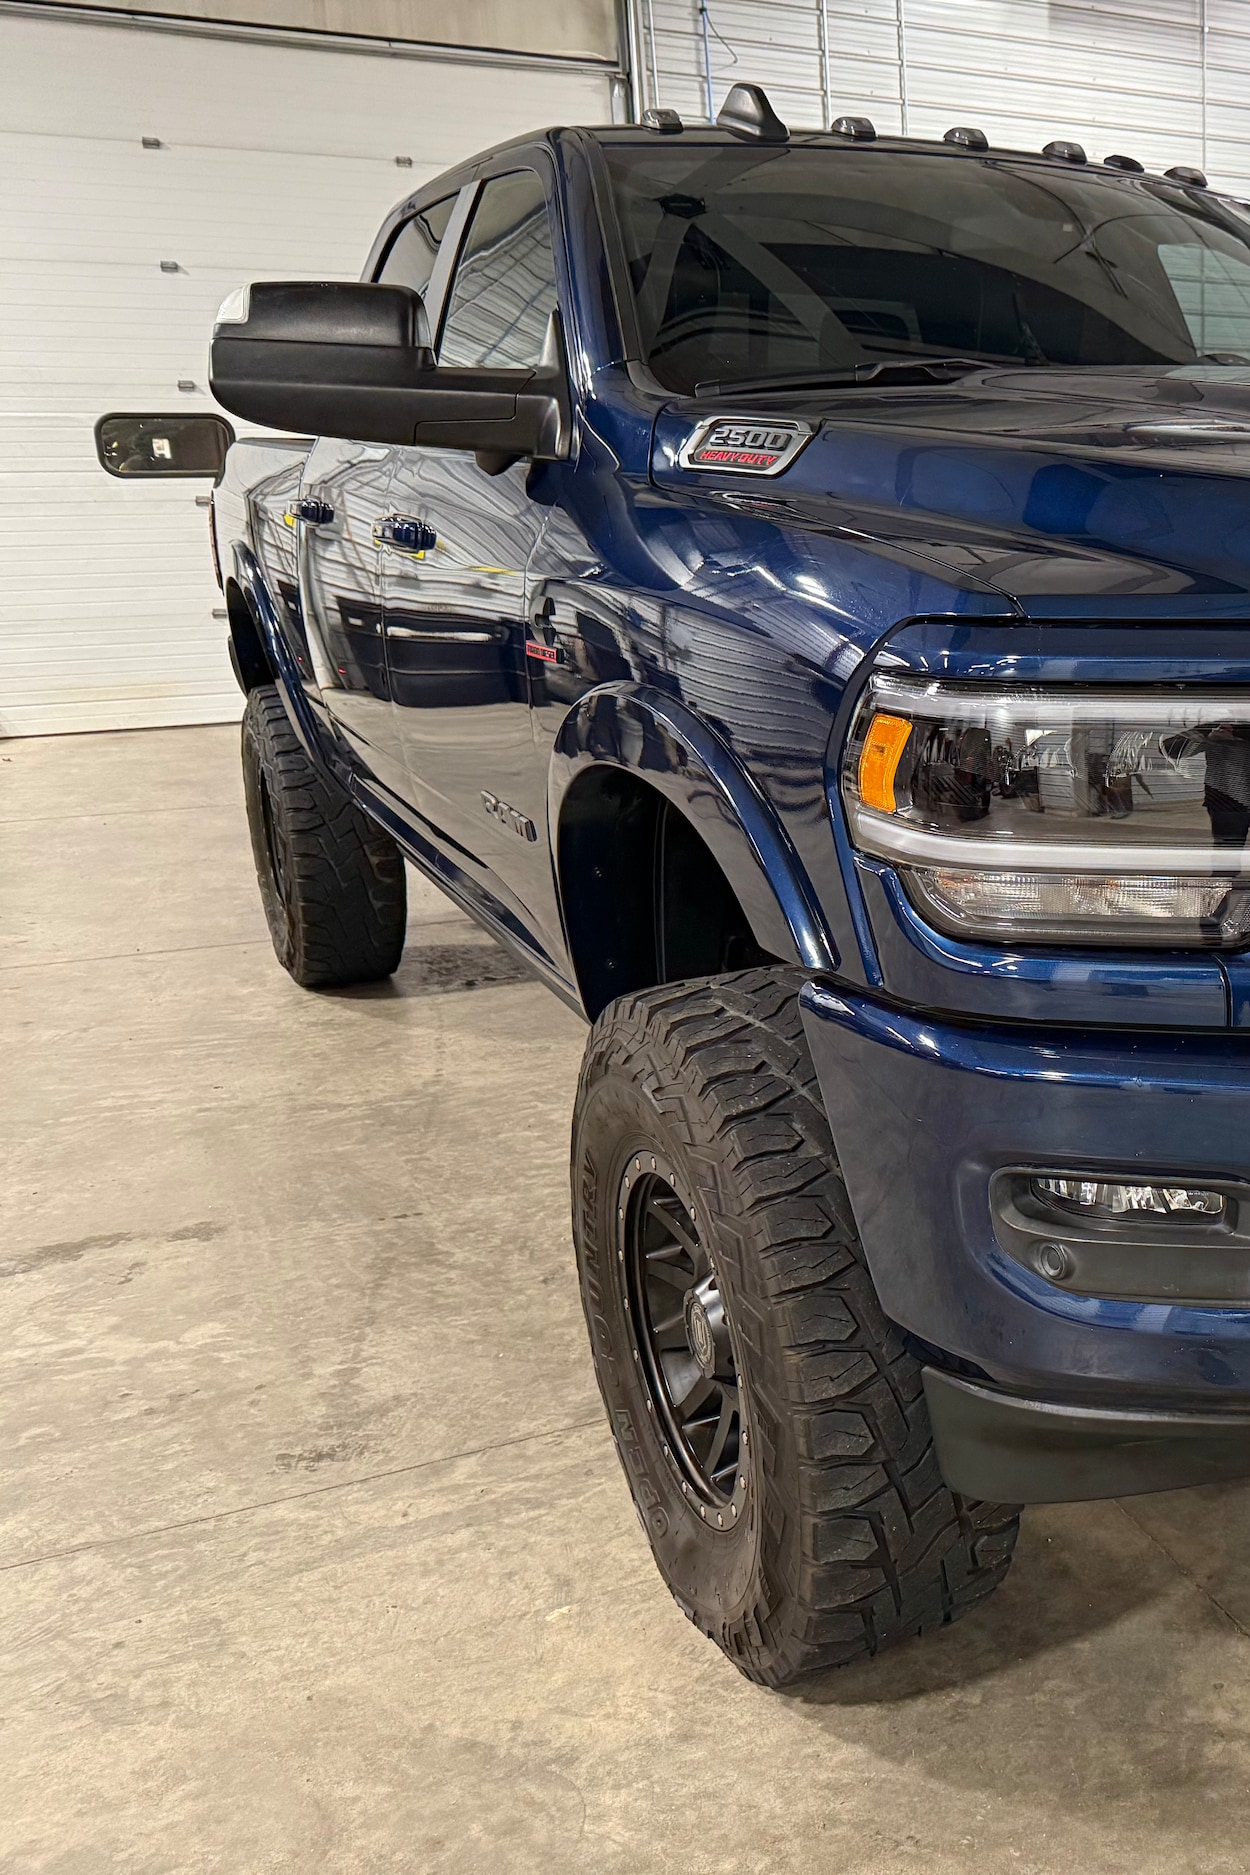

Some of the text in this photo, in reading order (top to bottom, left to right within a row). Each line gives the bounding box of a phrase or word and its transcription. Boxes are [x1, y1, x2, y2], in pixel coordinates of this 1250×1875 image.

[709, 428, 792, 451] 2500
[700, 451, 777, 466] HEAVY DUTY
[614, 1408, 670, 1539] OPEN
